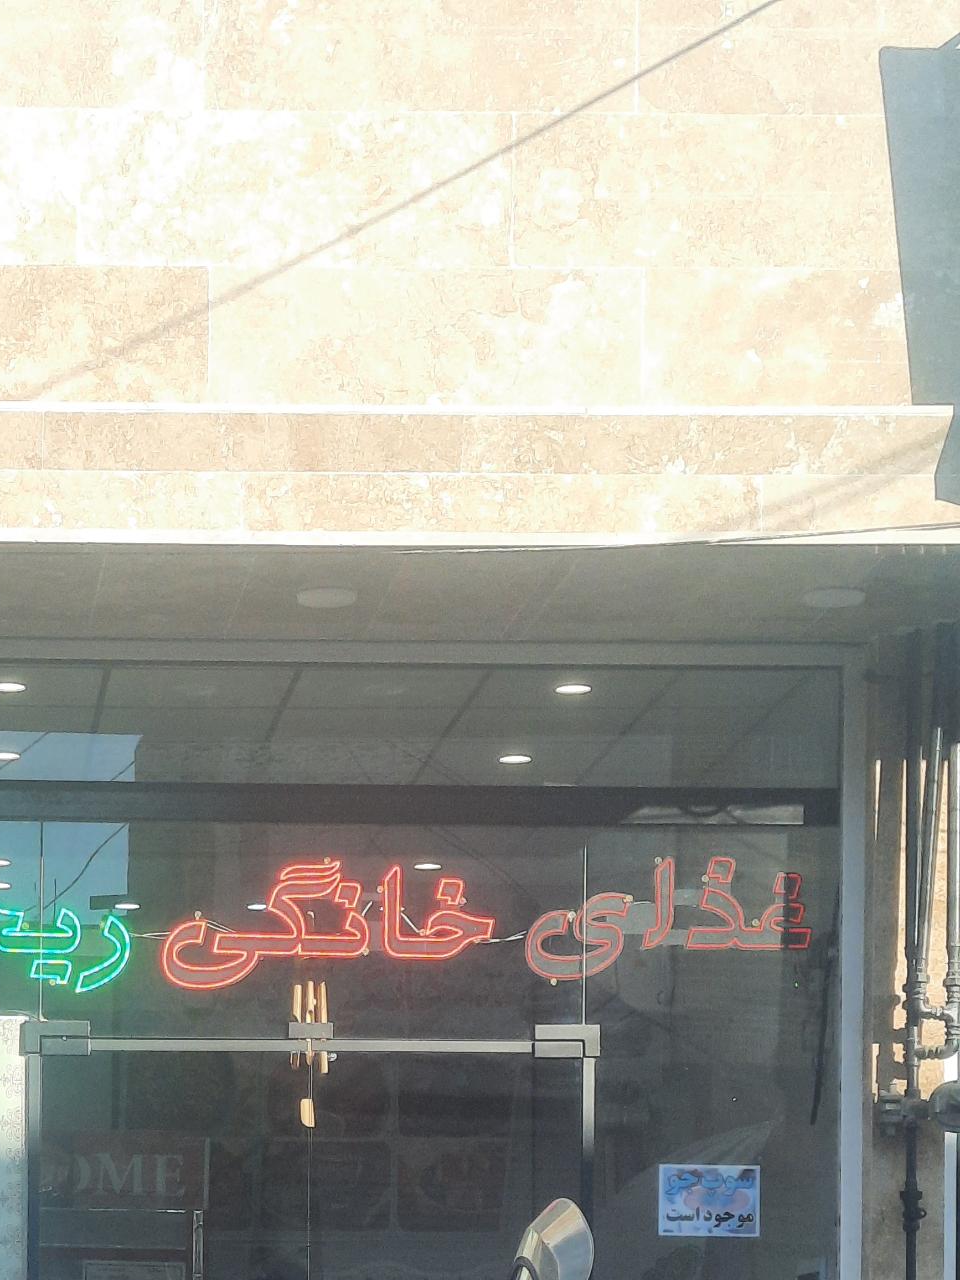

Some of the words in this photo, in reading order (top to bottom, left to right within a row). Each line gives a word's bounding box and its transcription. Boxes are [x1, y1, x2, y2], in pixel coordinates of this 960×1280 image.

[163, 859, 496, 989] خانگی
[524, 857, 812, 981] غذای
[666, 1206, 700, 1222] است
[703, 1209, 754, 1228] موجود
